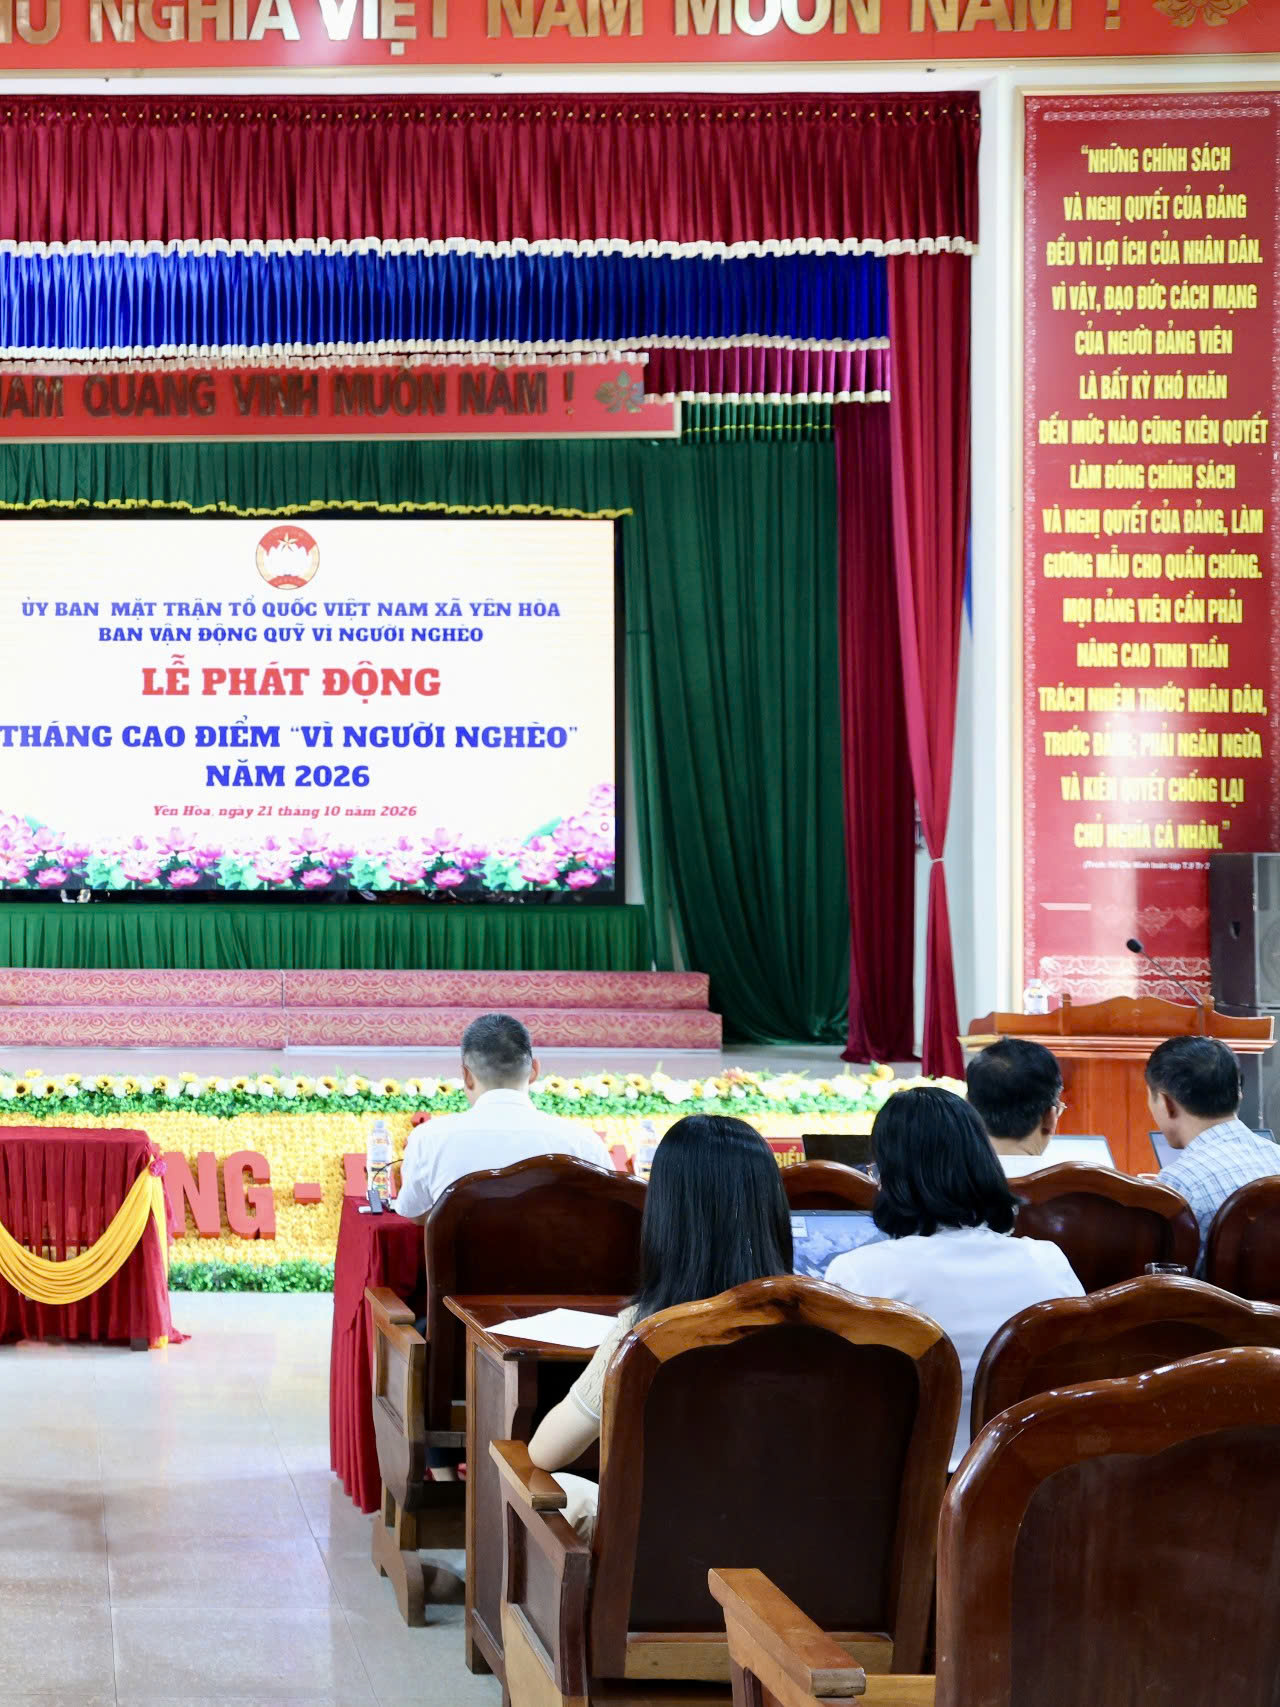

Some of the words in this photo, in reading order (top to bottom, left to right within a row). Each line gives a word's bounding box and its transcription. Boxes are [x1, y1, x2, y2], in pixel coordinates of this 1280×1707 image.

[1080, 142, 1139, 174] “NHỮNG
[1141, 142, 1188, 173] CHÍNH
[1190, 141, 1231, 172] SÁCH
[1063, 191, 1084, 222] VÀ
[1085, 195, 1122, 226] NGHỊ
[1124, 186, 1171, 223] QUYẾT
[1172, 184, 1203, 220] CỦA
[1205, 183, 1247, 219] ĐẢNG
[1045, 232, 1076, 267] ĐỀU
[1077, 235, 1093, 266] VÌ
[1095, 238, 1119, 272] LỢI
[1121, 235, 1148, 266] ÍCH
[1149, 229, 1181, 266] CỦA
[1183, 234, 1225, 265] NHÂN
[1227, 233, 1264, 264] DÂN.
[1051, 280, 1067, 311] VÌ
[1068, 280, 1102, 316] VẬY,
[1103, 285, 1134, 316] ĐẠO
[1136, 278, 1167, 310] ĐỨC
[1169, 279, 1210, 310] CÁCH
[1212, 283, 1257, 315] MẠNG
[1074, 319, 1105, 356] CỦA
[1107, 323, 1153, 355] NGƯỜI
[1154, 319, 1196, 355] ĐẢNG
[1198, 324, 1233, 355] VIÊN
[82, 372, 217, 417] QUANG
[231, 372, 319, 417] VINH
[1079, 369, 1099, 400] LÀ
[1100, 366, 1130, 400] BẤT
[1131, 369, 1152, 400] KỲ
[1153, 369, 1184, 400] KHÓ
[1186, 369, 1228, 400] KHĂN
[1069, 458, 1103, 489] LÀM
[1103, 459, 1145, 490] ĐÚNG
[1147, 459, 1193, 490] CHÍNH
[1195, 459, 1236, 489] SÁCH
[21, 596, 49, 617] ỦY
[55, 601, 100, 617] BAN
[111, 598, 158, 621] MẶT
[163, 598, 223, 621] TRẬN
[228, 597, 257, 617] TỔ
[261, 598, 318, 618] QUỐC
[323, 598, 371, 621] VIỆT
[377, 602, 429, 617] NAM
[434, 598, 463, 617] XÃ
[469, 598, 512, 617] YÊN
[98, 627, 143, 642] BAN
[149, 623, 192, 646] VẬN
[197, 623, 258, 646] ĐỘNG
[263, 622, 306, 643] QUỸ
[338, 625, 405, 643] NGƯỜI
[141, 653, 190, 696] LỄ
[201, 661, 311, 696] PHÁT
[321, 660, 441, 705] ĐỘNG
[121, 725, 186, 748] CAO
[194, 714, 281, 748] ĐIỂM
[342, 721, 446, 749] NGƯỜI
[205, 758, 286, 787] NĂM
[294, 764, 370, 788] 2026
[256, 805, 273, 817] 21
[323, 805, 341, 817] 10
[379, 805, 417, 817] 2026
